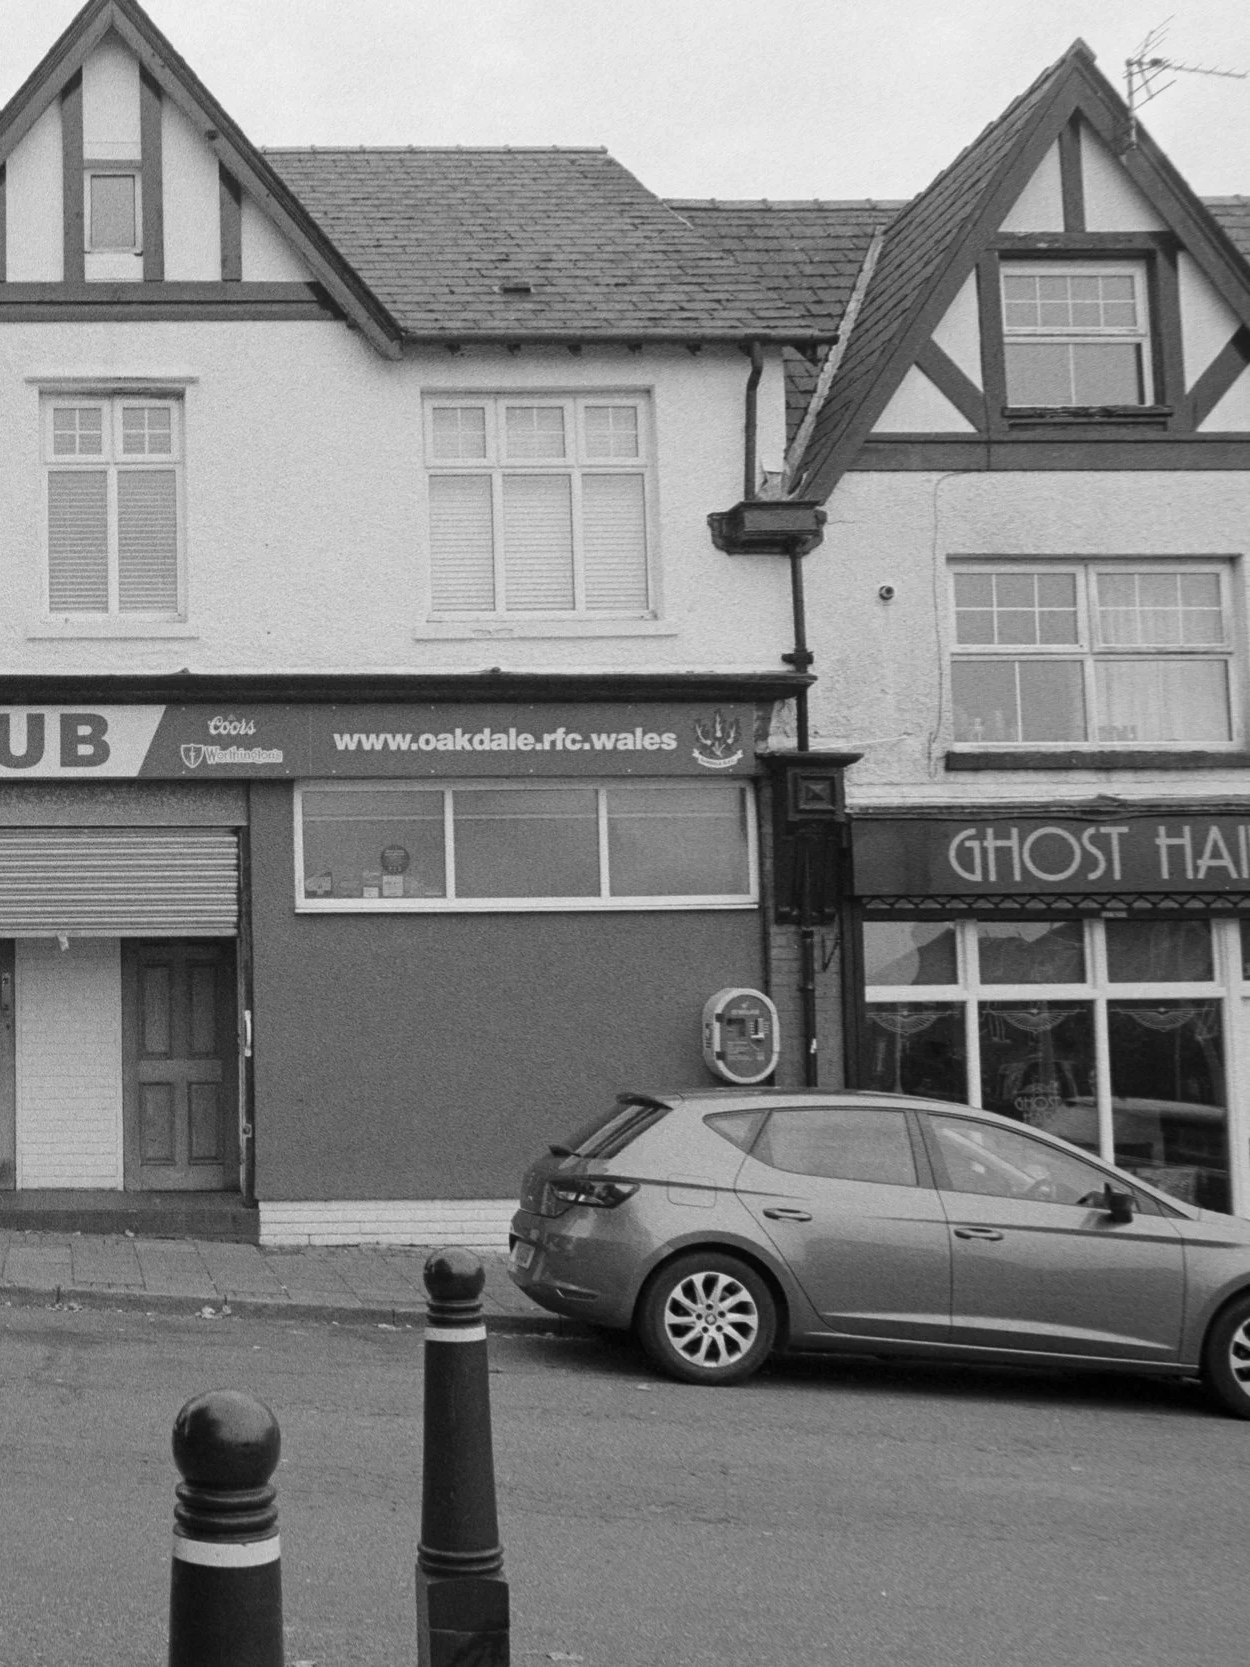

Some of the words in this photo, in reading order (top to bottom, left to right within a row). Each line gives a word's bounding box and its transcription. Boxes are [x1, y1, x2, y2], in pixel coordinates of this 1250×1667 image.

[207, 716, 257, 735] Coors
[333, 727, 678, 751] www.oakdale.rfc.wales
[204, 745, 283, 765] Worthington's
[948, 826, 1130, 882] GHOST
[1154, 825, 1250, 880] HAI
